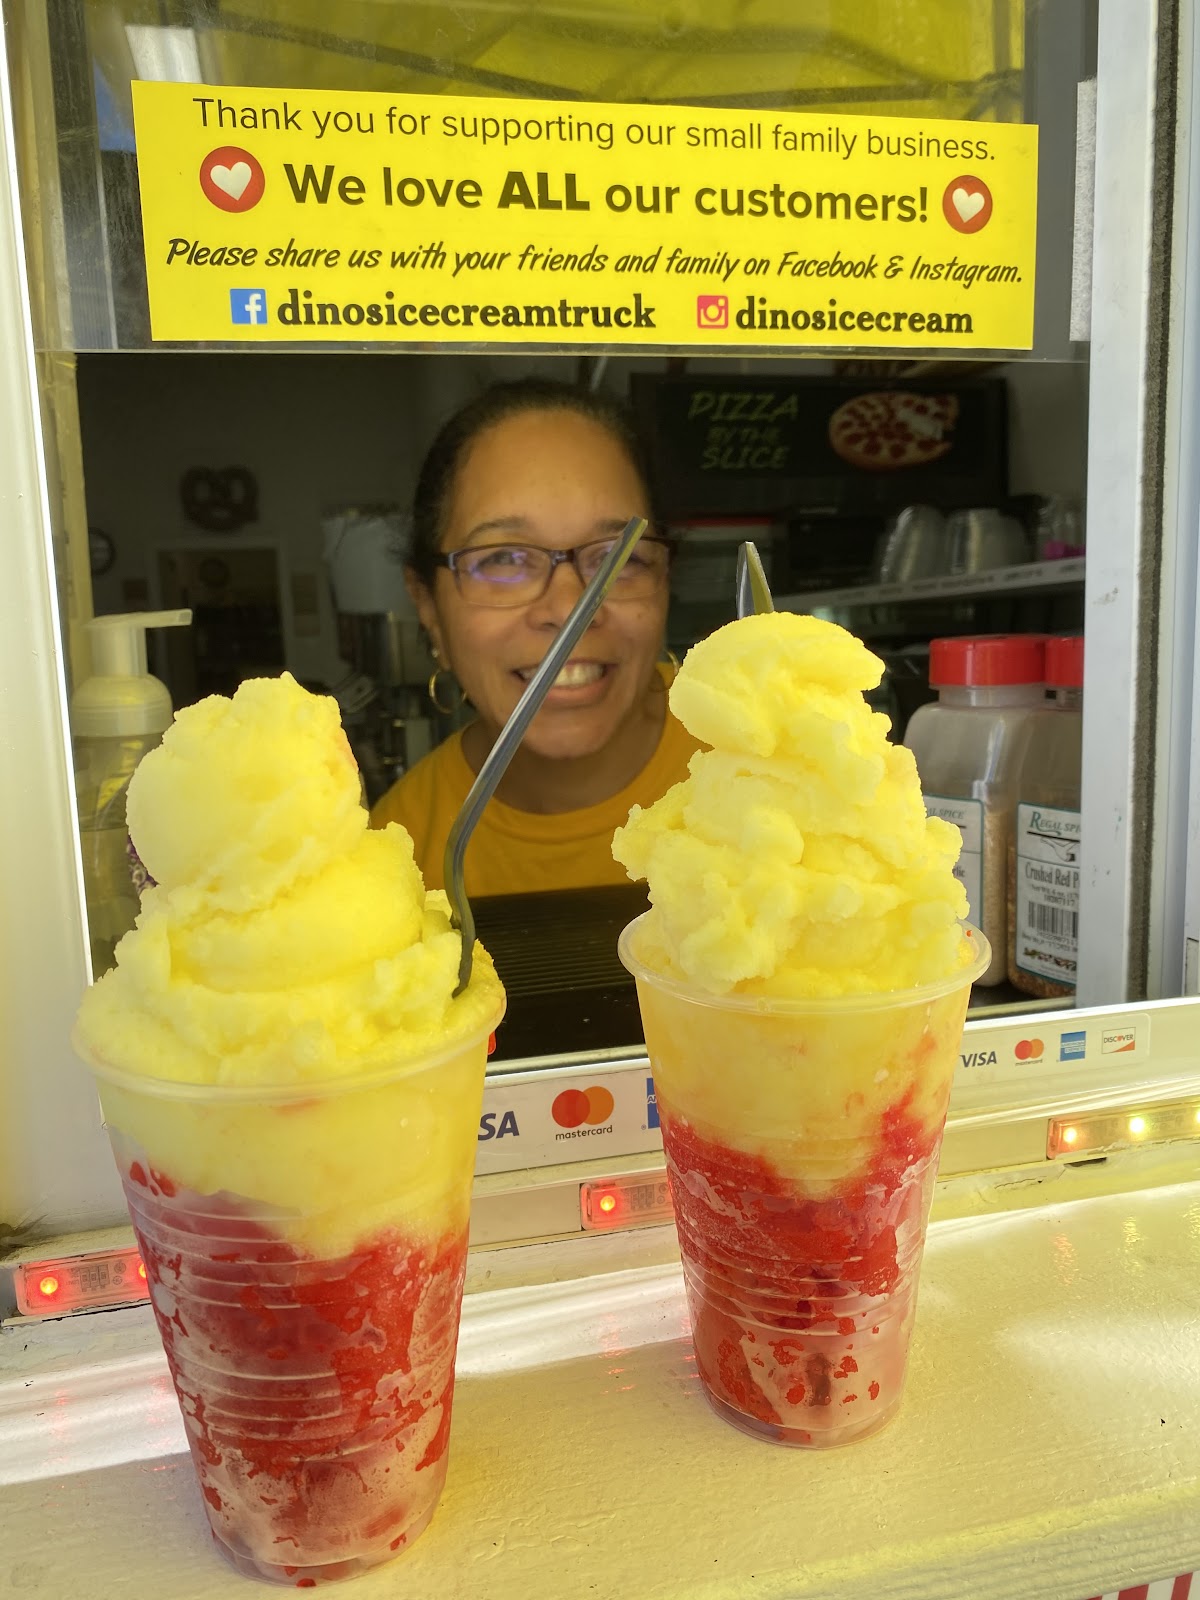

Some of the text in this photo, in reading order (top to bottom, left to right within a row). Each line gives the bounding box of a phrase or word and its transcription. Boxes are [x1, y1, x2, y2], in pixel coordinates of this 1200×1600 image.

[193, 98, 994, 160] Thank you for supporting our small family business.
[283, 164, 927, 222] We love ALL our customers!
[167, 238, 1021, 289] Please share us with your friends and family on Facebook & Instagram.
[278, 289, 656, 328] dinosicecreamtruck
[736, 296, 973, 333] dinosicecream
[688, 391, 799, 422] PIZZA
[700, 446, 790, 470] SLICE
[938, 808, 964, 820] SPICE
[1029, 811, 1062, 835] REGAL
[952, 865, 966, 878] rlic
[1025, 861, 1053, 884] Crushed
[1055, 868, 1071, 888] Red
[1104, 1034, 1134, 1044] DISCOVER
[959, 1051, 997, 1068] VISA
[478, 1111, 520, 1141] SA
[555, 1125, 613, 1141] mastercard
